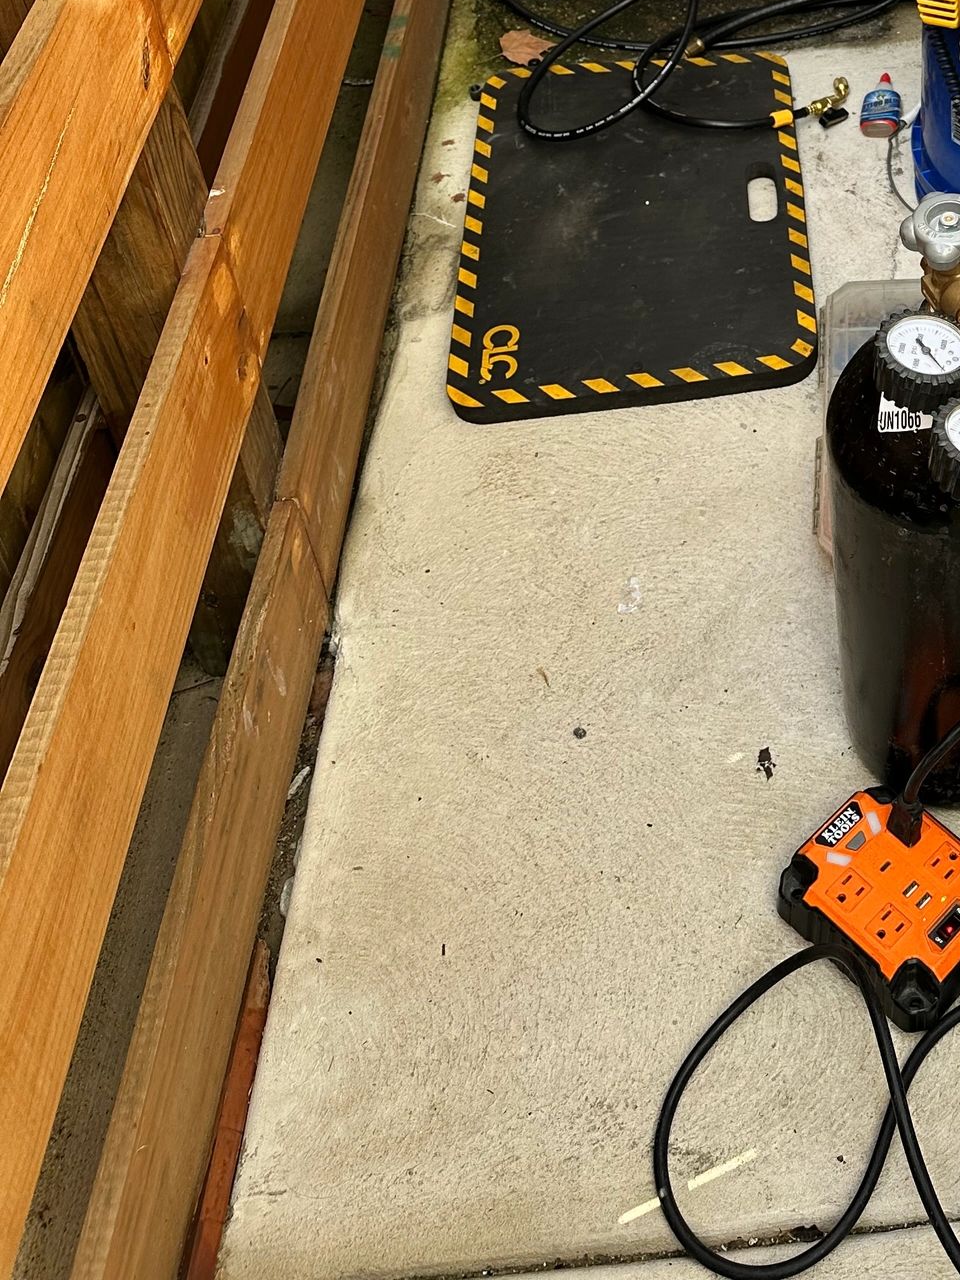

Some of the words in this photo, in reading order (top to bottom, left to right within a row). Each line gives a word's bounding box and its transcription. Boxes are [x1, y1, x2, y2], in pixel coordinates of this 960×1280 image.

[880, 410, 921, 431] UN1066
[821, 807, 855, 840] KLEIN
[827, 813, 861, 845] TOOLS
